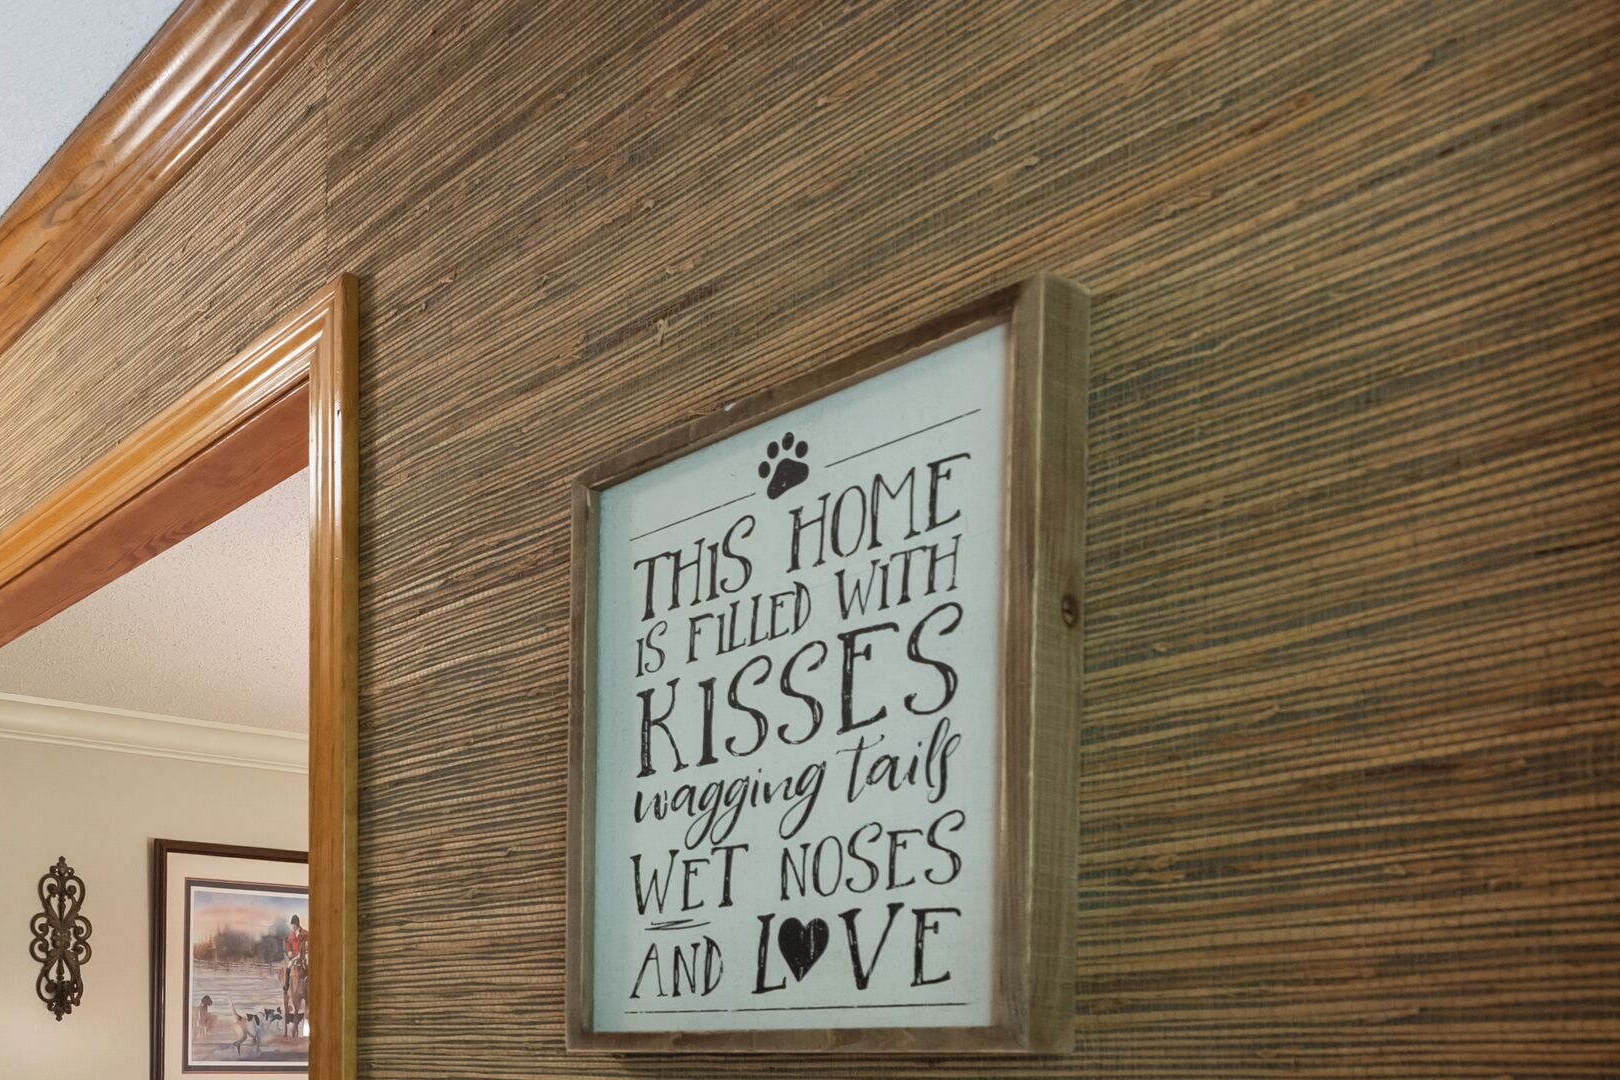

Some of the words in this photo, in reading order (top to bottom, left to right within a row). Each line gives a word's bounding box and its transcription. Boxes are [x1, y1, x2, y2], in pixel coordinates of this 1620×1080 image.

[633, 514, 756, 622] THIS
[785, 452, 972, 574] HOME
[635, 620, 668, 678] IS
[684, 580, 812, 664] FILLED
[833, 533, 963, 621] WITH
[635, 601, 964, 779] KISSES
[633, 760, 827, 851] wagging
[836, 716, 962, 805] tails
[629, 843, 750, 916] WET
[779, 809, 966, 902] NOSES
[628, 934, 725, 1000] AND
